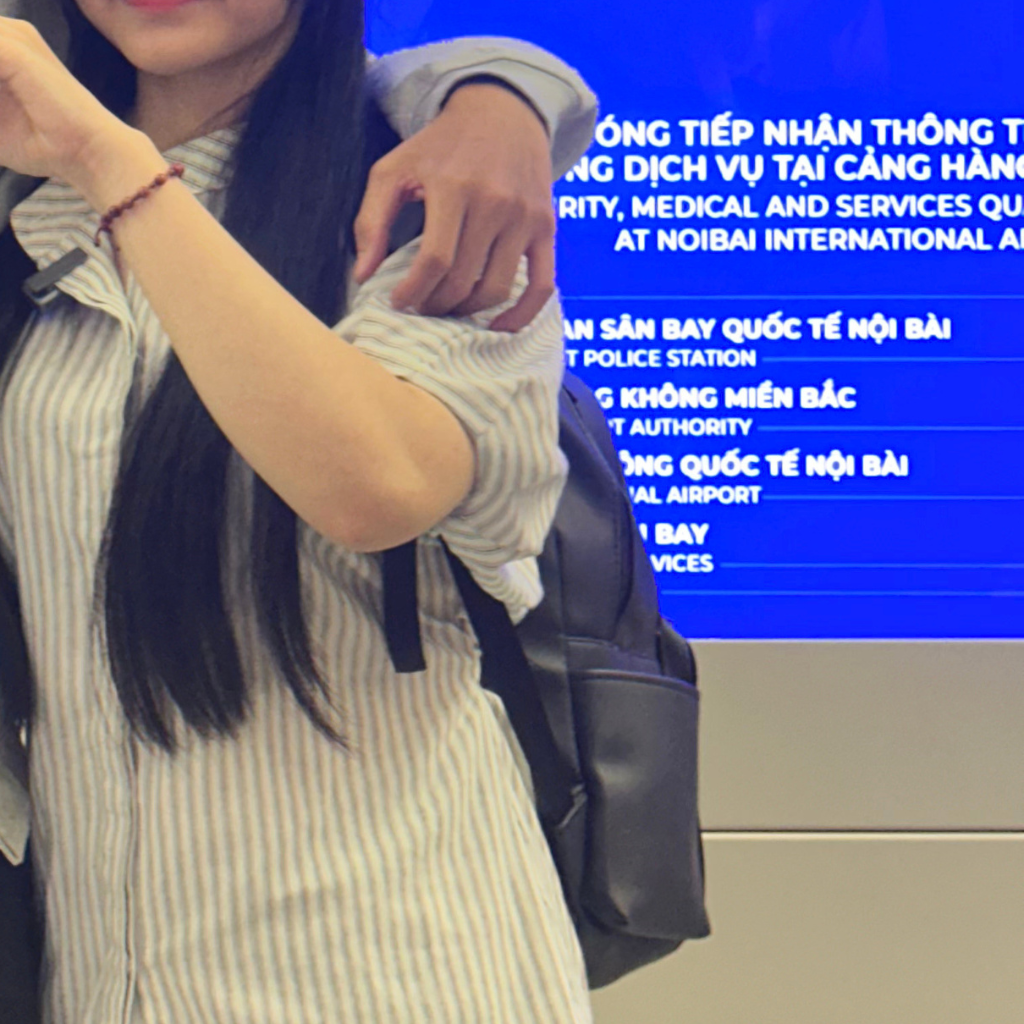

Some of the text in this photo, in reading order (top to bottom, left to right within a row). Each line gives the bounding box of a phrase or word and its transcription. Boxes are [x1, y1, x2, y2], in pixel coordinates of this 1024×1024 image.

[594, 111, 1024, 152] ÓNG TIẾP NHẬN THÔNG T
[565, 155, 614, 182] NG
[624, 155, 707, 188] DỊCH
[715, 155, 764, 188] VỤ
[772, 154, 825, 188] TẠI
[834, 145, 931, 181] CẢNG
[558, 193, 1024, 222] RITY, MEDICAL AND SERVICES QU
[614, 228, 650, 251] AT
[657, 228, 756, 251] NOIBAI
[765, 227, 992, 251] INTERNATIONAL
[600, 313, 656, 340] SÂN
[662, 318, 716, 340] BAY
[722, 311, 802, 344] QUỐC
[807, 311, 842, 340] TẾ
[848, 312, 897, 344] NỘI
[904, 312, 951, 340] BÀI
[583, 349, 661, 368] POLICE
[666, 349, 756, 367] STATION
[594, 387, 614, 409] G
[620, 382, 718, 409] KHÔNG
[800, 378, 857, 409] BẮC
[629, 417, 752, 436] AUTHORITY
[619, 448, 909, 482] ÔNG QUỐC TẾ NỘI BÀI
[629, 485, 762, 504] AL AIRPORT
[654, 522, 709, 545] BAY
[650, 553, 714, 573] VICES
